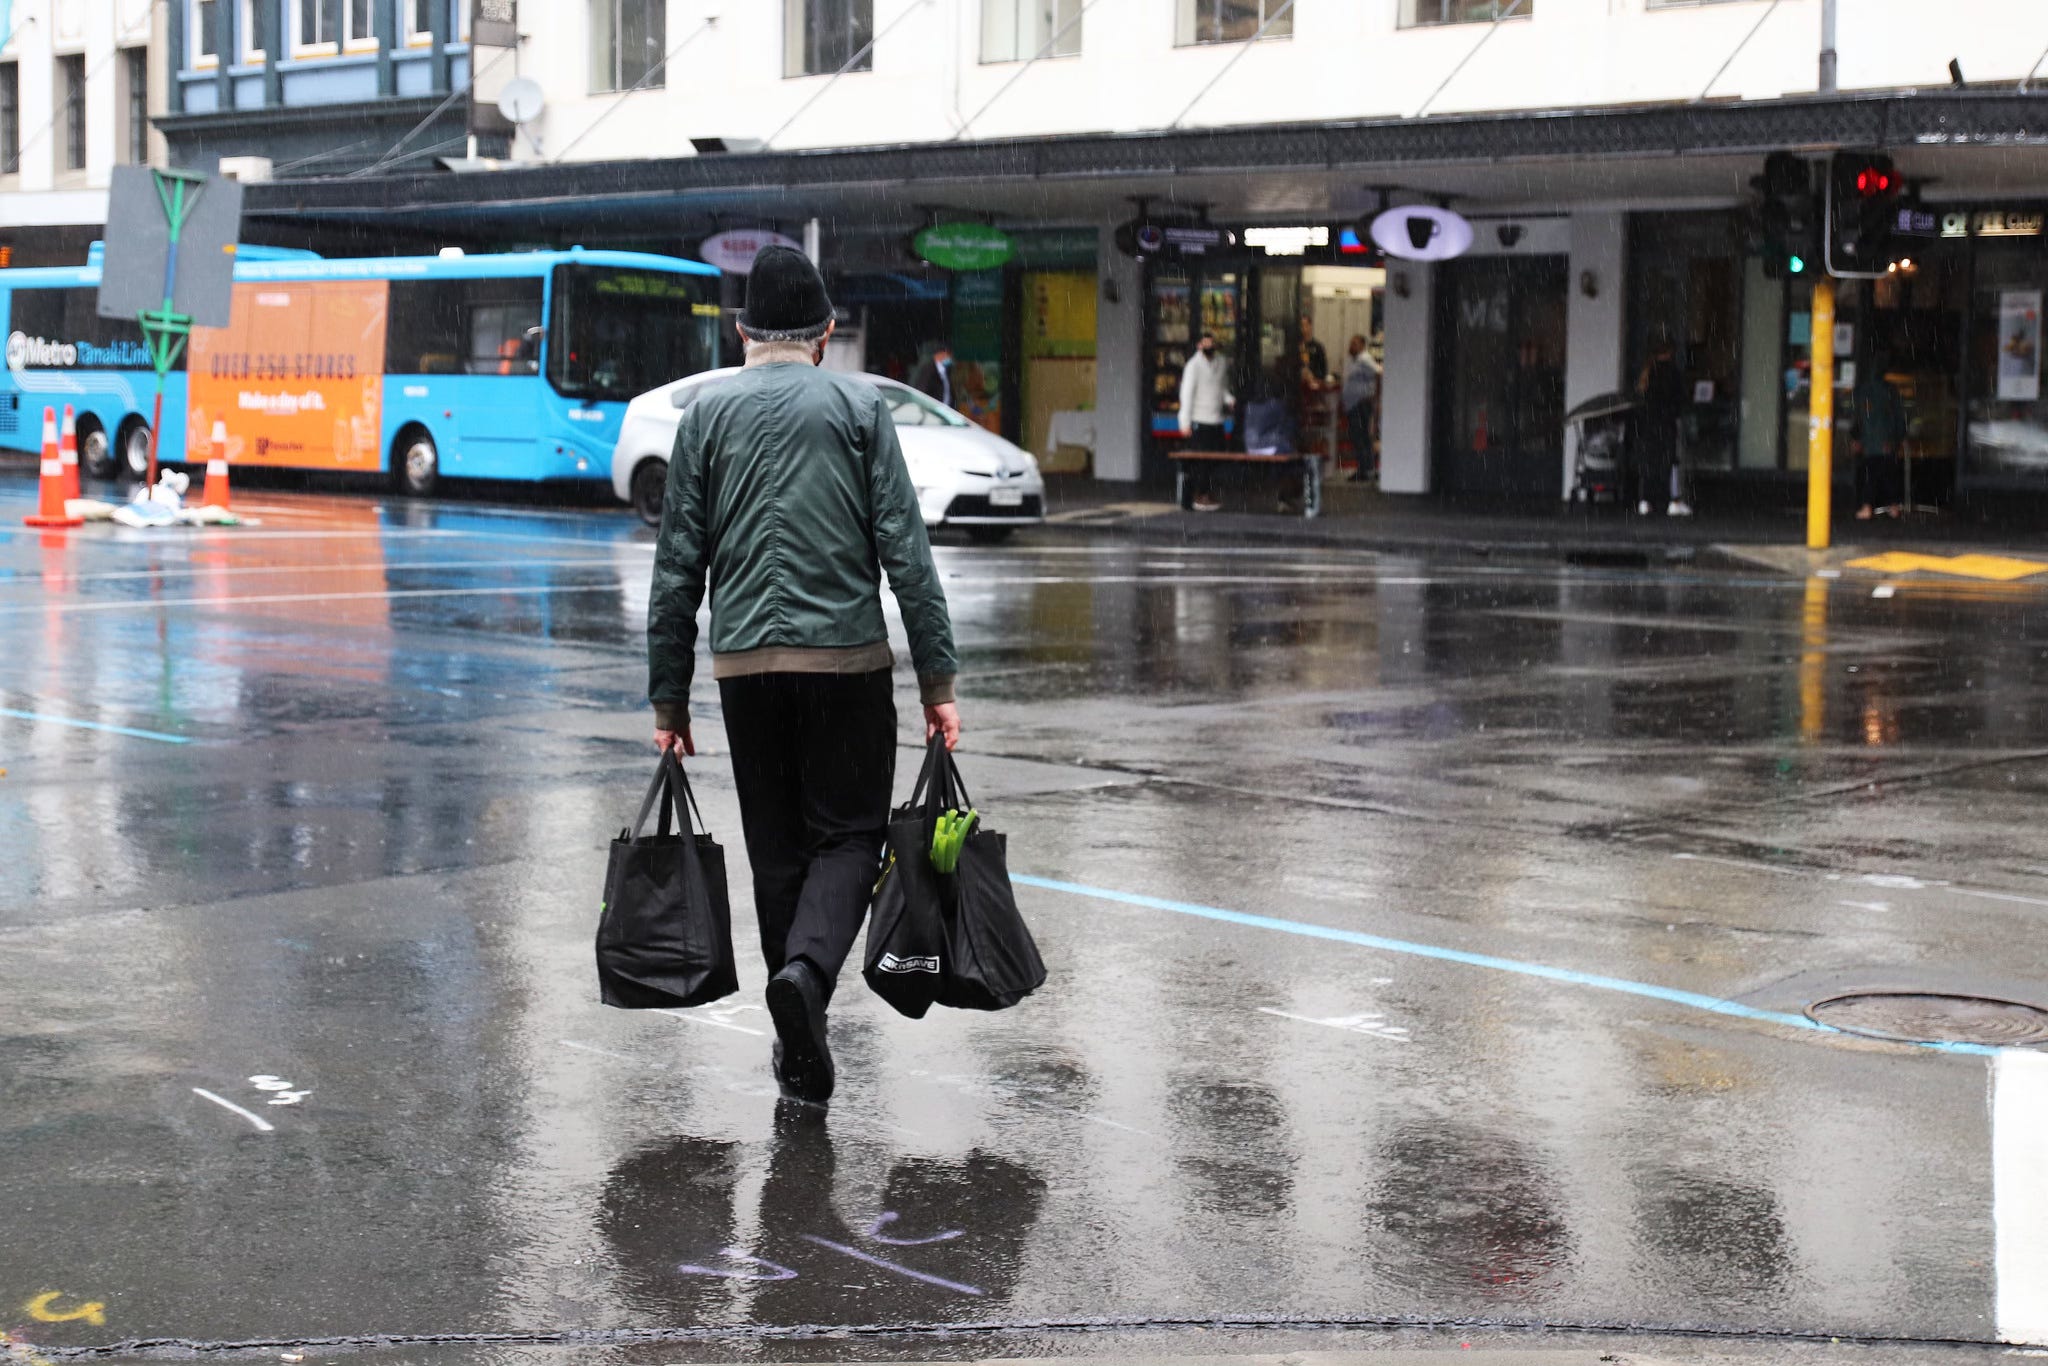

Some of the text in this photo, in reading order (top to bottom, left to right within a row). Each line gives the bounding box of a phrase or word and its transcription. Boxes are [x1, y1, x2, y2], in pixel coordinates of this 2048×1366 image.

[26, 336, 77, 366] Metro
[211, 352, 356, 381] OVER 250 STORES
